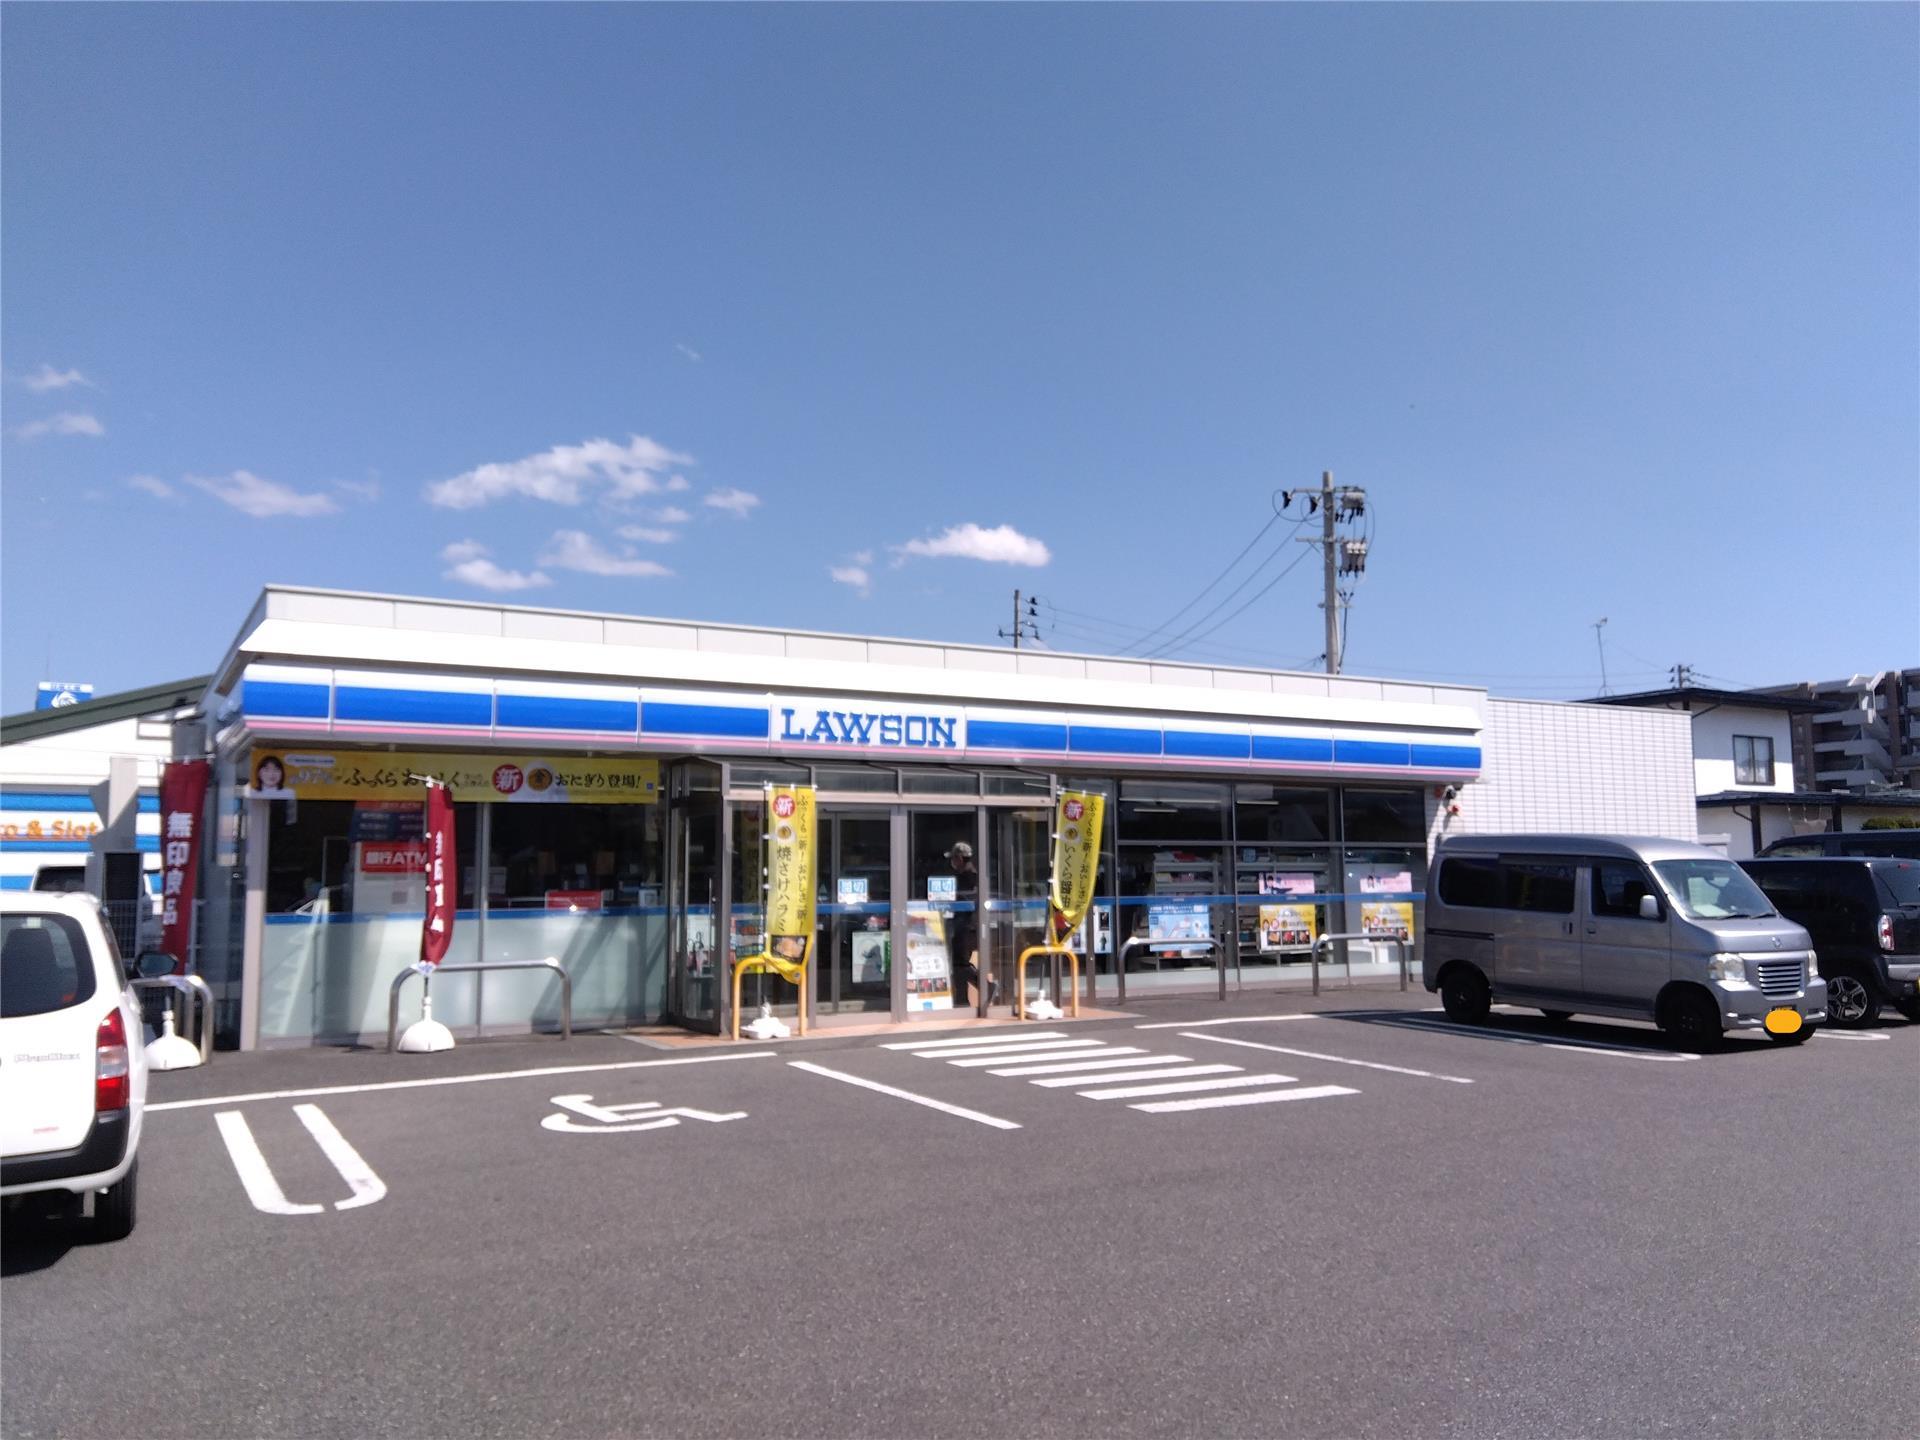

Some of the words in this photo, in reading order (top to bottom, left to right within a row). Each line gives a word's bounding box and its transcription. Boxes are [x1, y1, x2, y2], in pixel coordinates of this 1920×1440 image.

[781, 708, 957, 747] LAWSON
[495, 768, 521, 792] 新
[555, 773, 642, 789] おにぎり登場!
[775, 797, 794, 816] 新
[1066, 802, 1082, 820] 新
[27, 820, 42, 836] &
[163, 811, 193, 925] 無印良品
